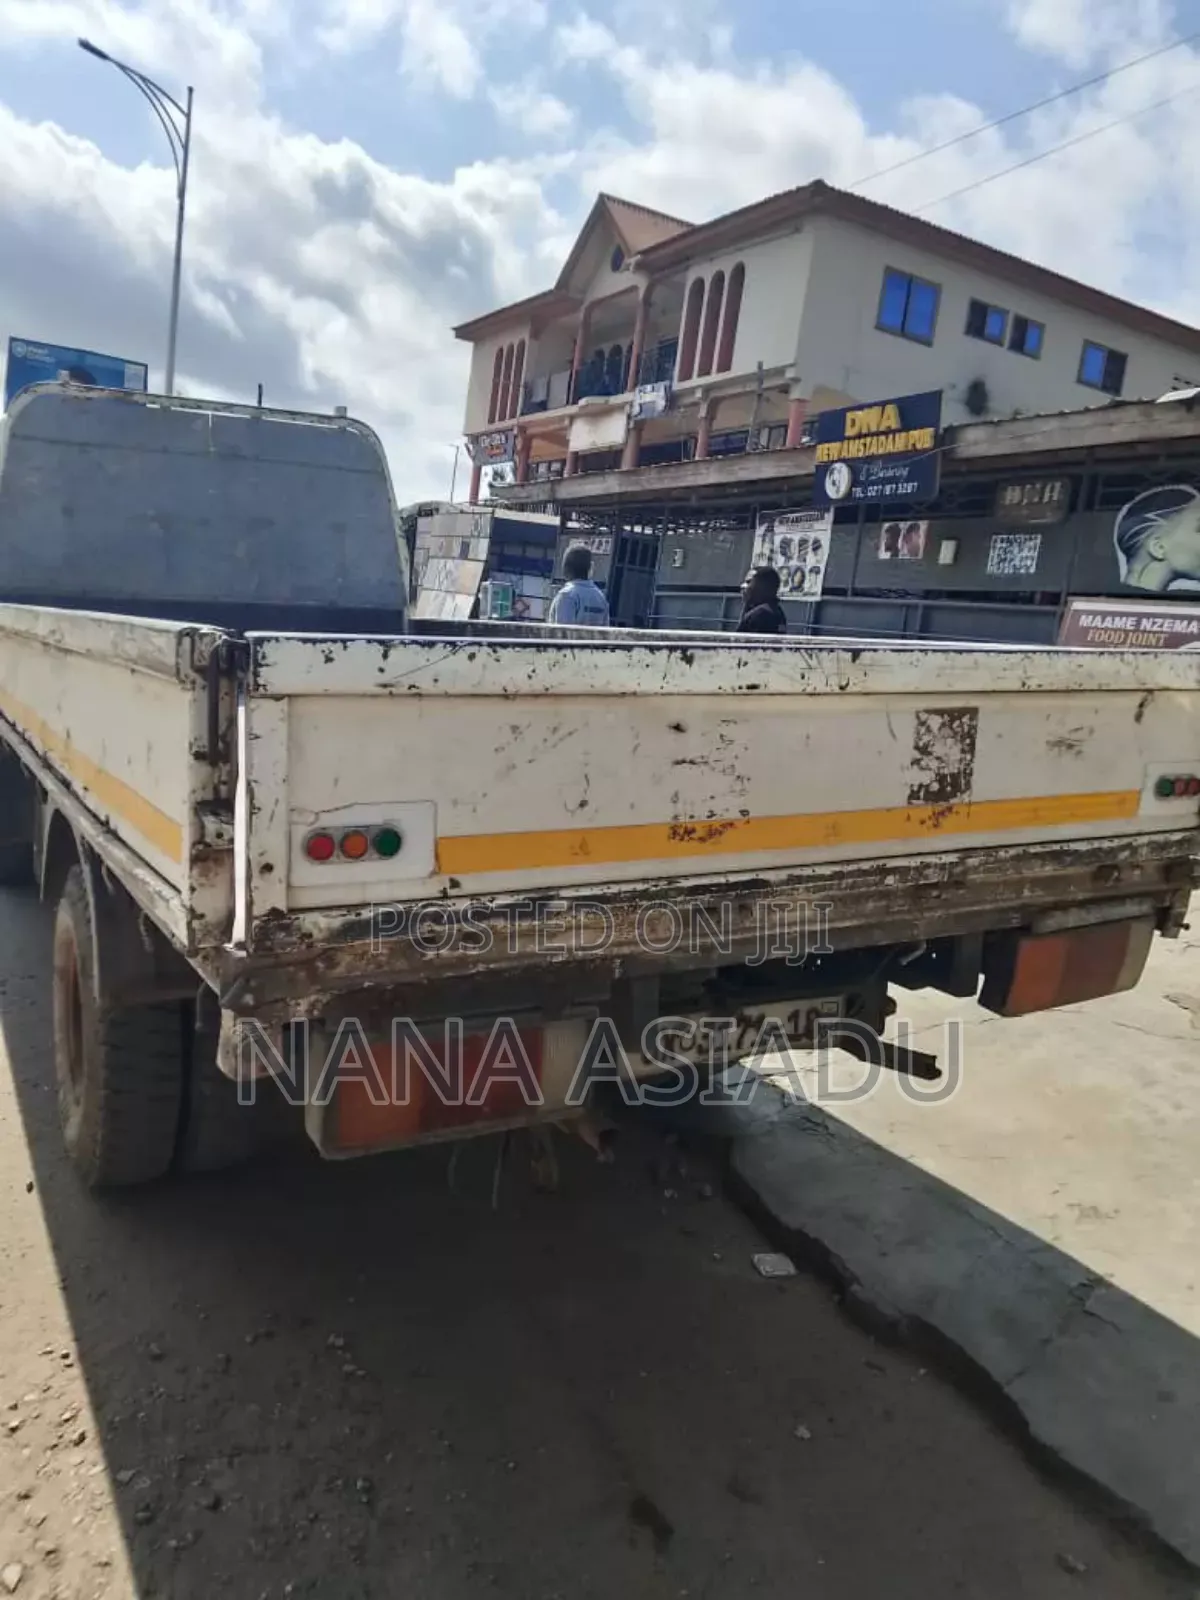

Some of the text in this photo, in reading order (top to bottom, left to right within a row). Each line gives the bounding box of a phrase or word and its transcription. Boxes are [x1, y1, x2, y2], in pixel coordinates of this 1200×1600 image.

[844, 404, 901, 437] DNA
[1079, 614, 1198, 634] MAAME NZEMA
[1087, 629, 1169, 647] FOOD JOINT
